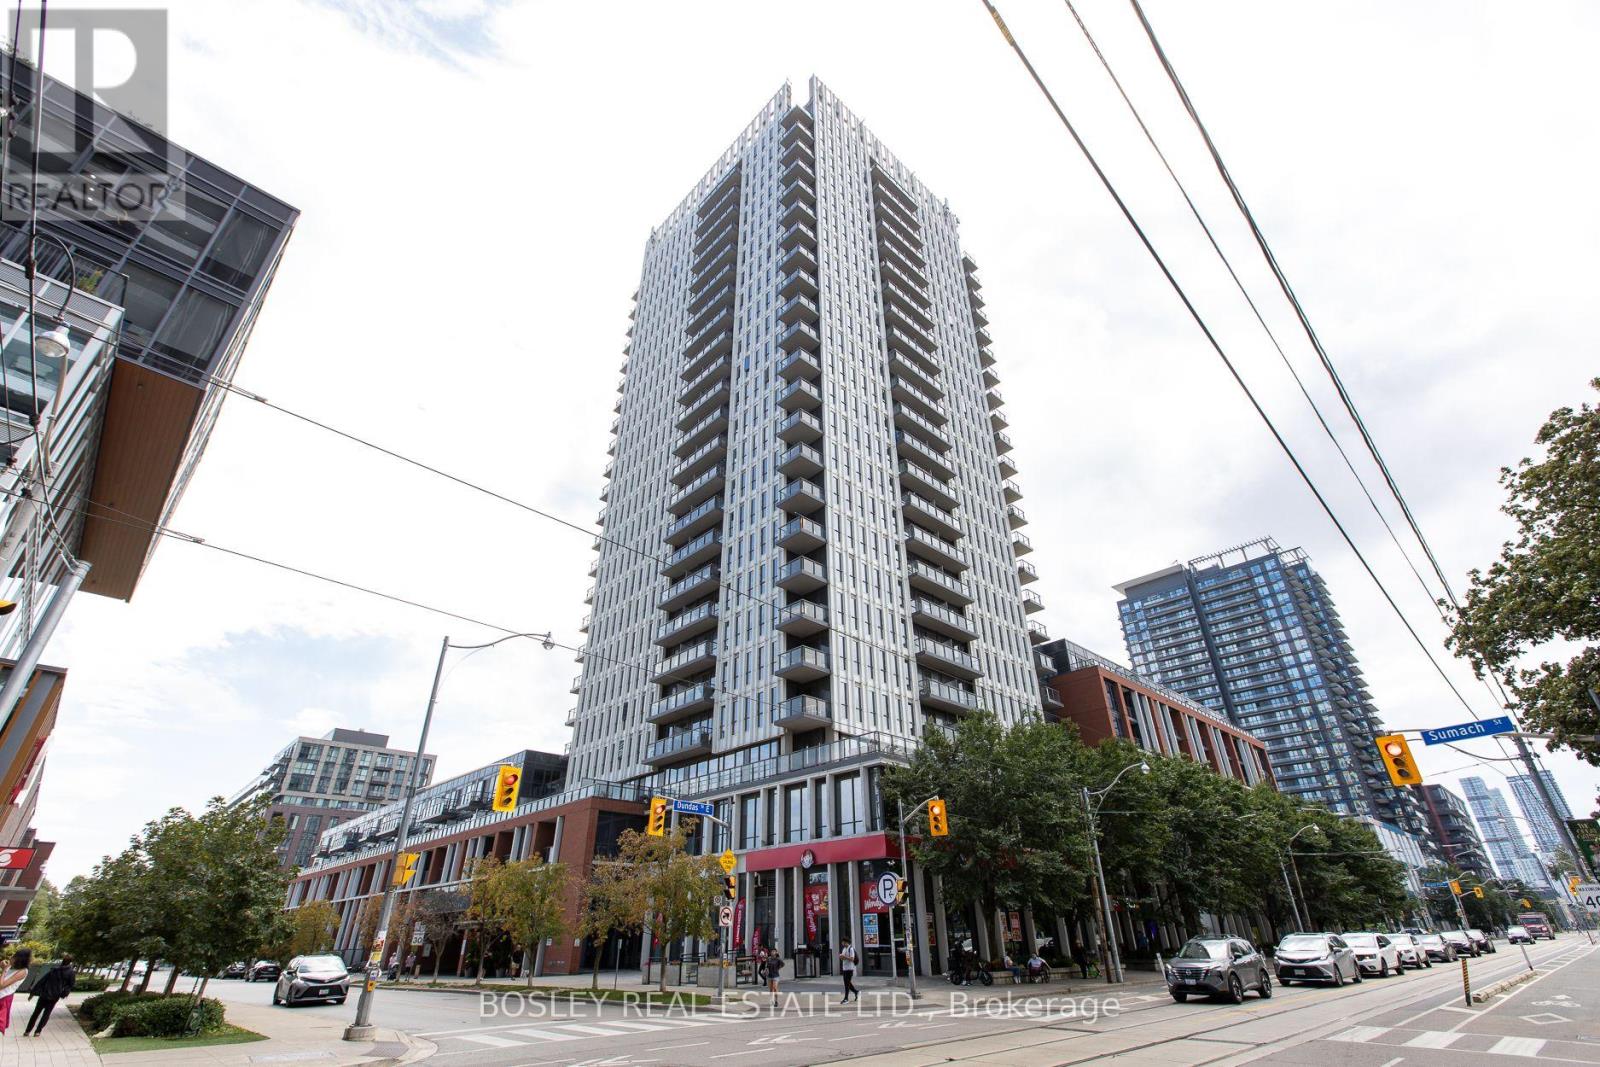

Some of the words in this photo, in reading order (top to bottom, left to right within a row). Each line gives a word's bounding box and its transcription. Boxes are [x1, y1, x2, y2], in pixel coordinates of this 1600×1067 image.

[1428, 723, 1485, 741] Sumach
[677, 802, 698, 811] Dundas
[705, 805, 710, 813] E
[883, 879, 893, 898] P
